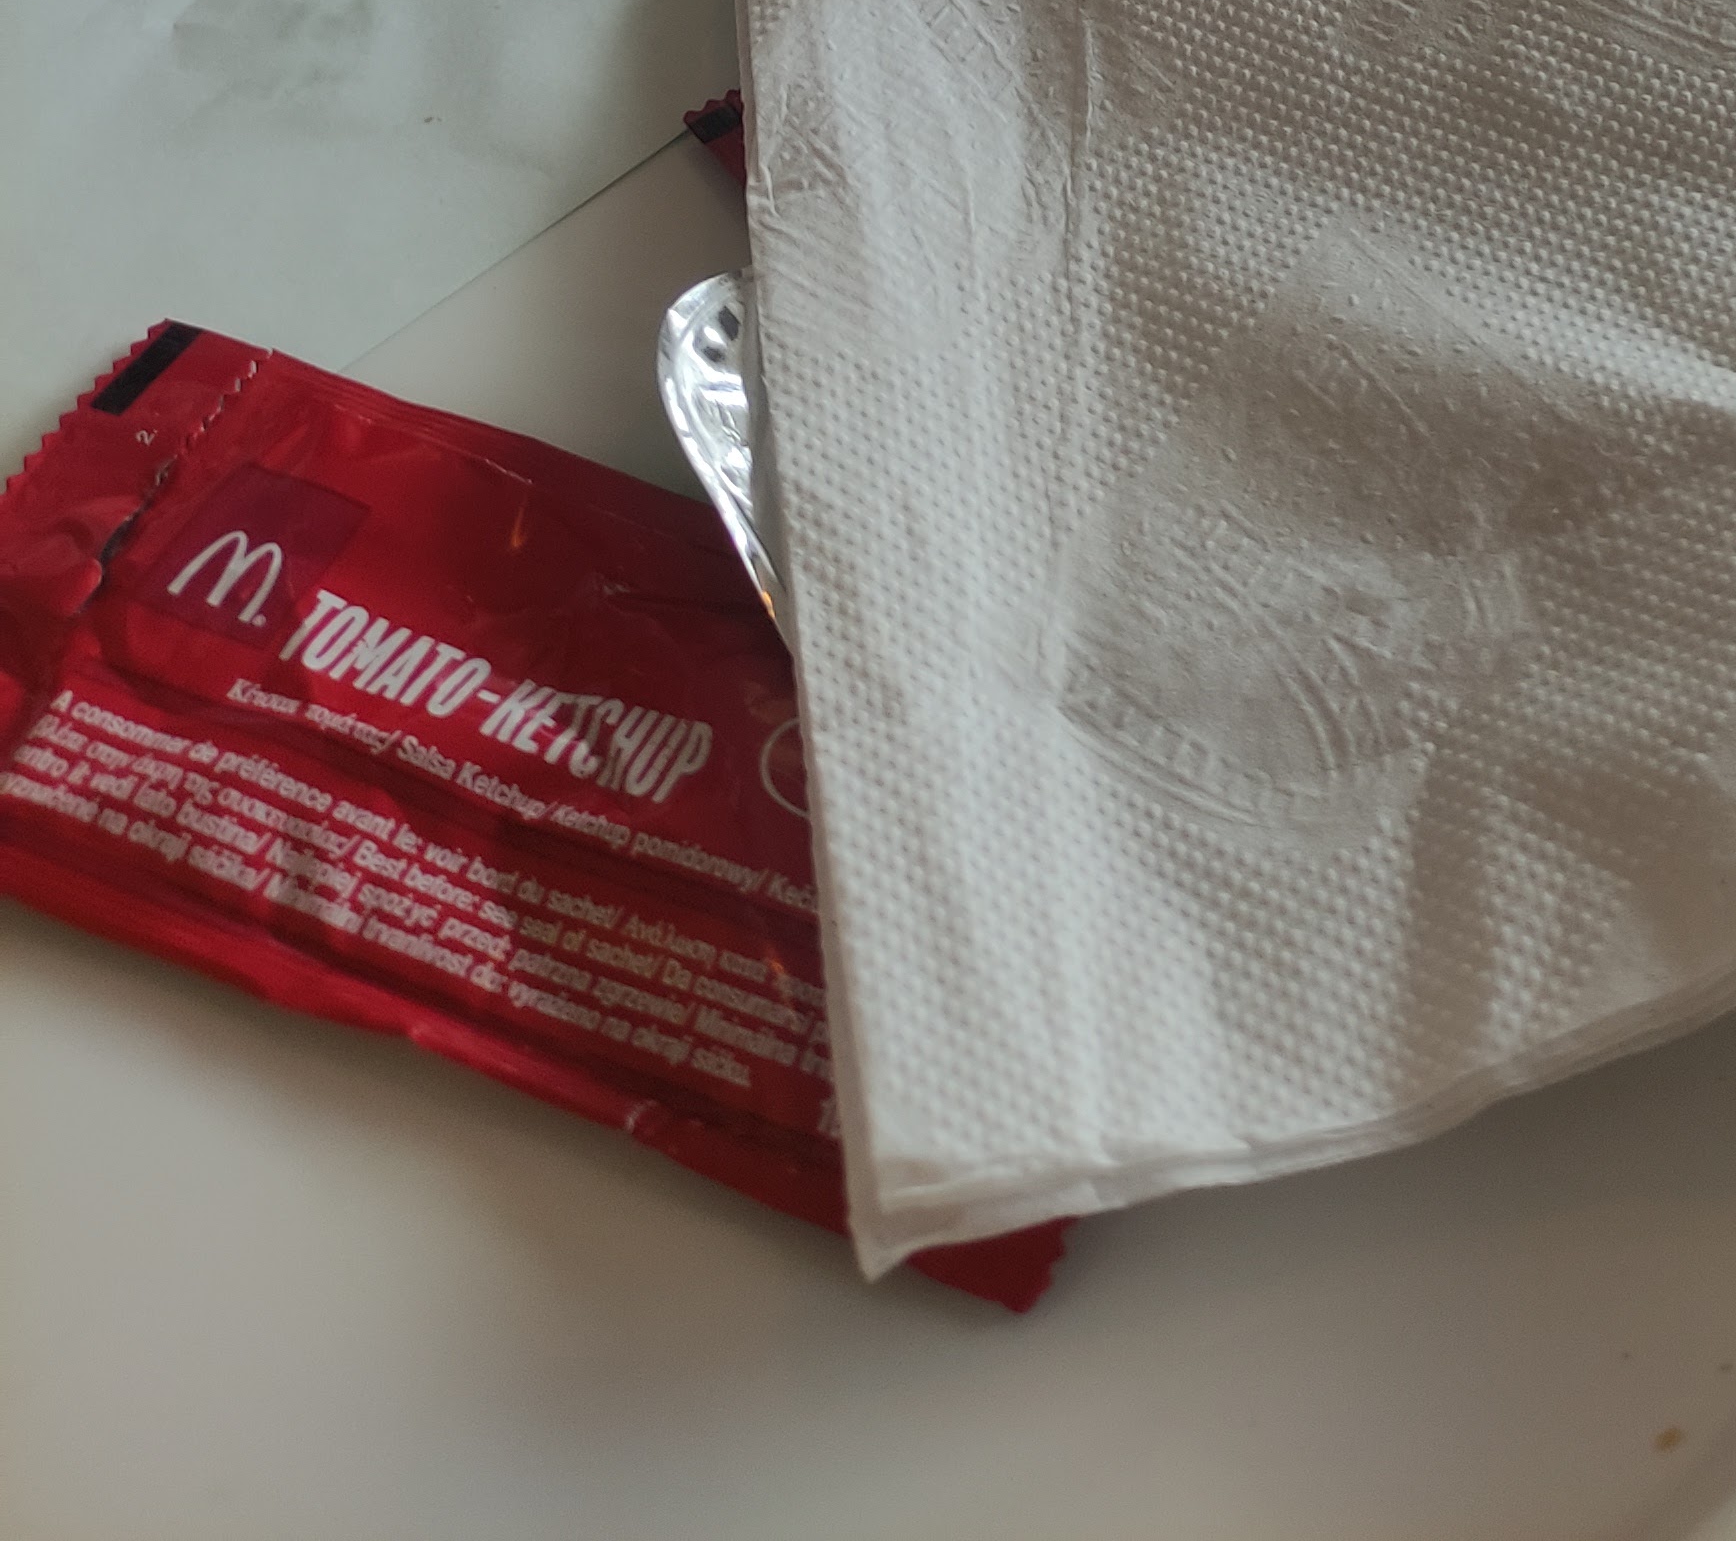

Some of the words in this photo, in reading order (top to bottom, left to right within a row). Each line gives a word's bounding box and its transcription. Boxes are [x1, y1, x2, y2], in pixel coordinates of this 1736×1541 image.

[280, 589, 713, 804] TOMATO-KETCHUP
[51, 690, 73, 712] A
[72, 703, 191, 754] consommer
[188, 742, 218, 764] de
[215, 752, 331, 811] préférence
[333, 801, 395, 841] avant
[392, 824, 422, 854] le:
[424, 844, 467, 873] voir
[466, 857, 517, 892] bord
[517, 878, 544, 904] du
[397, 733, 456, 779] Salsa
[551, 804, 630, 848] Ketchup
[353, 840, 407, 880] Best
[404, 864, 479, 911] before:
[478, 901, 514, 929] see
[519, 917, 562, 945] seal
[562, 930, 586, 952] of
[662, 958, 692, 990] Da
